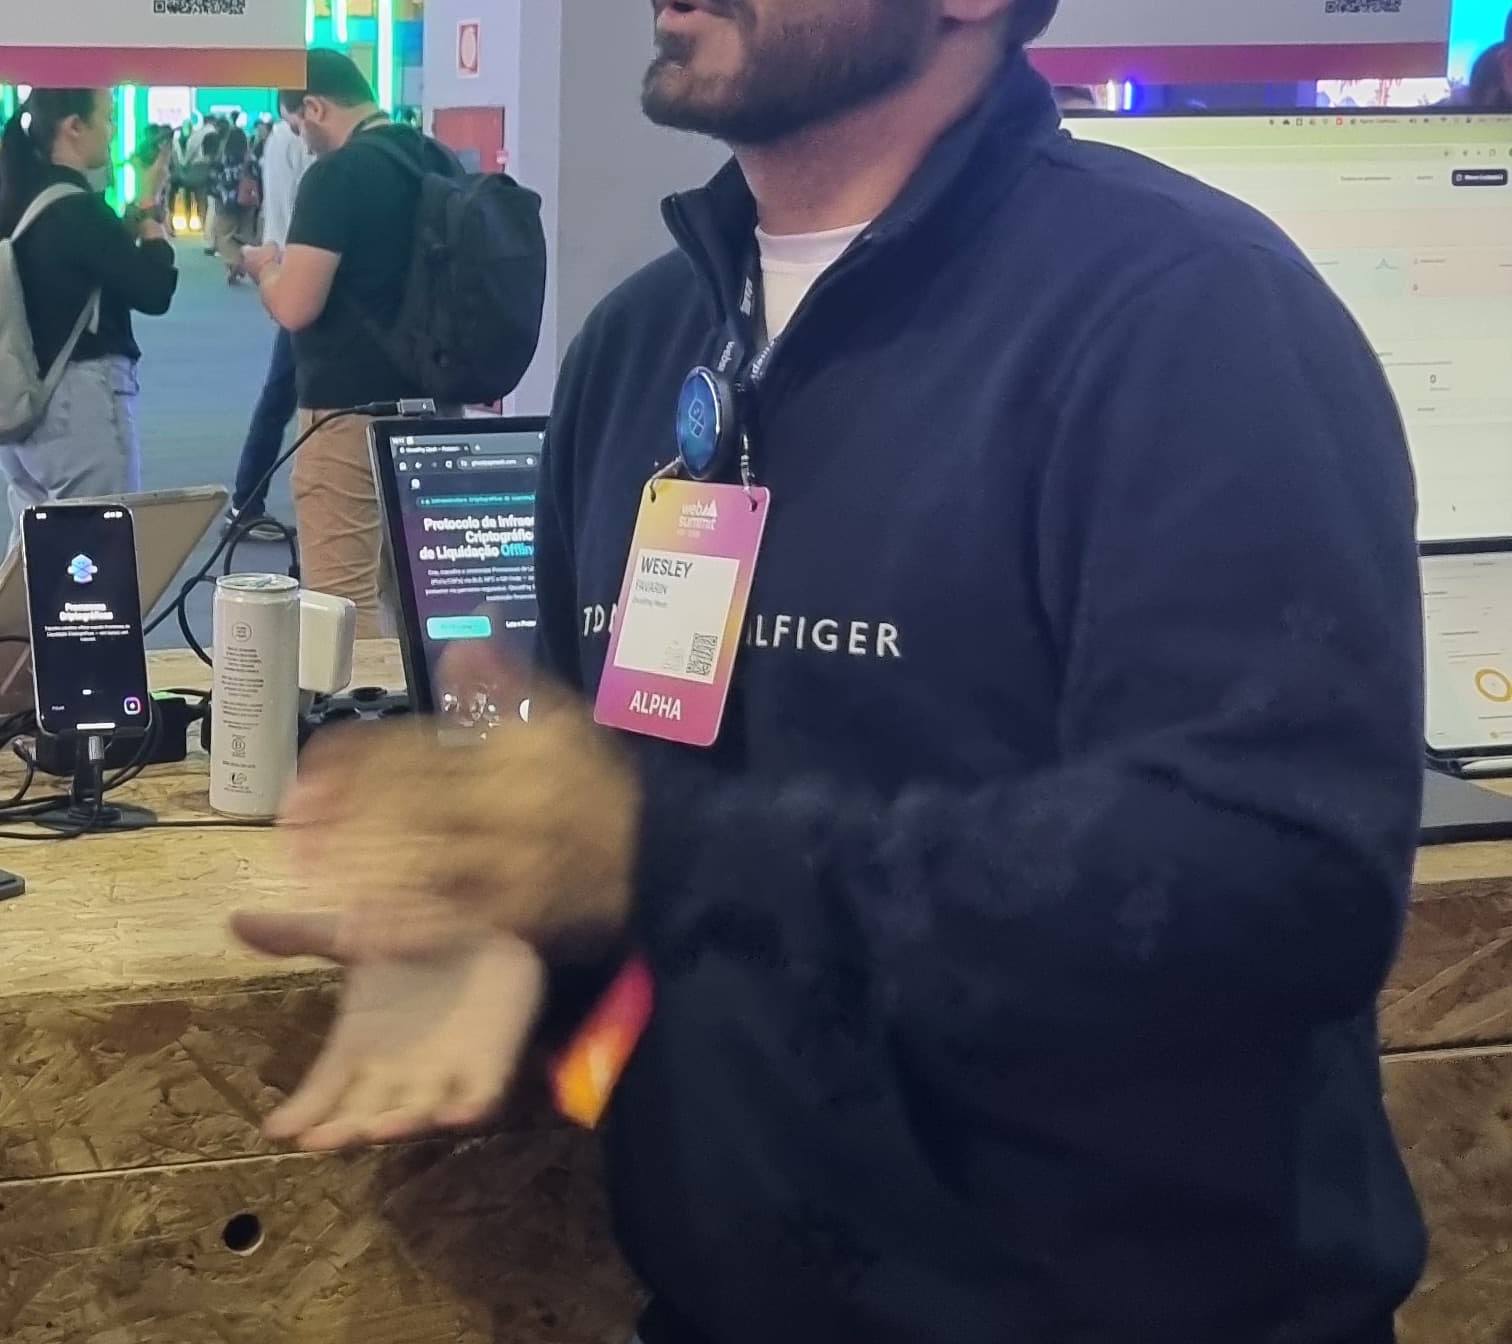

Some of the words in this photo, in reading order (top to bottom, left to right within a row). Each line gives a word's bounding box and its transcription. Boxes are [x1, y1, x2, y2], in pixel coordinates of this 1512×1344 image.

[423, 515, 480, 532] Protocolo
[641, 556, 693, 579] WESLEY
[629, 689, 682, 721] ALPHA
